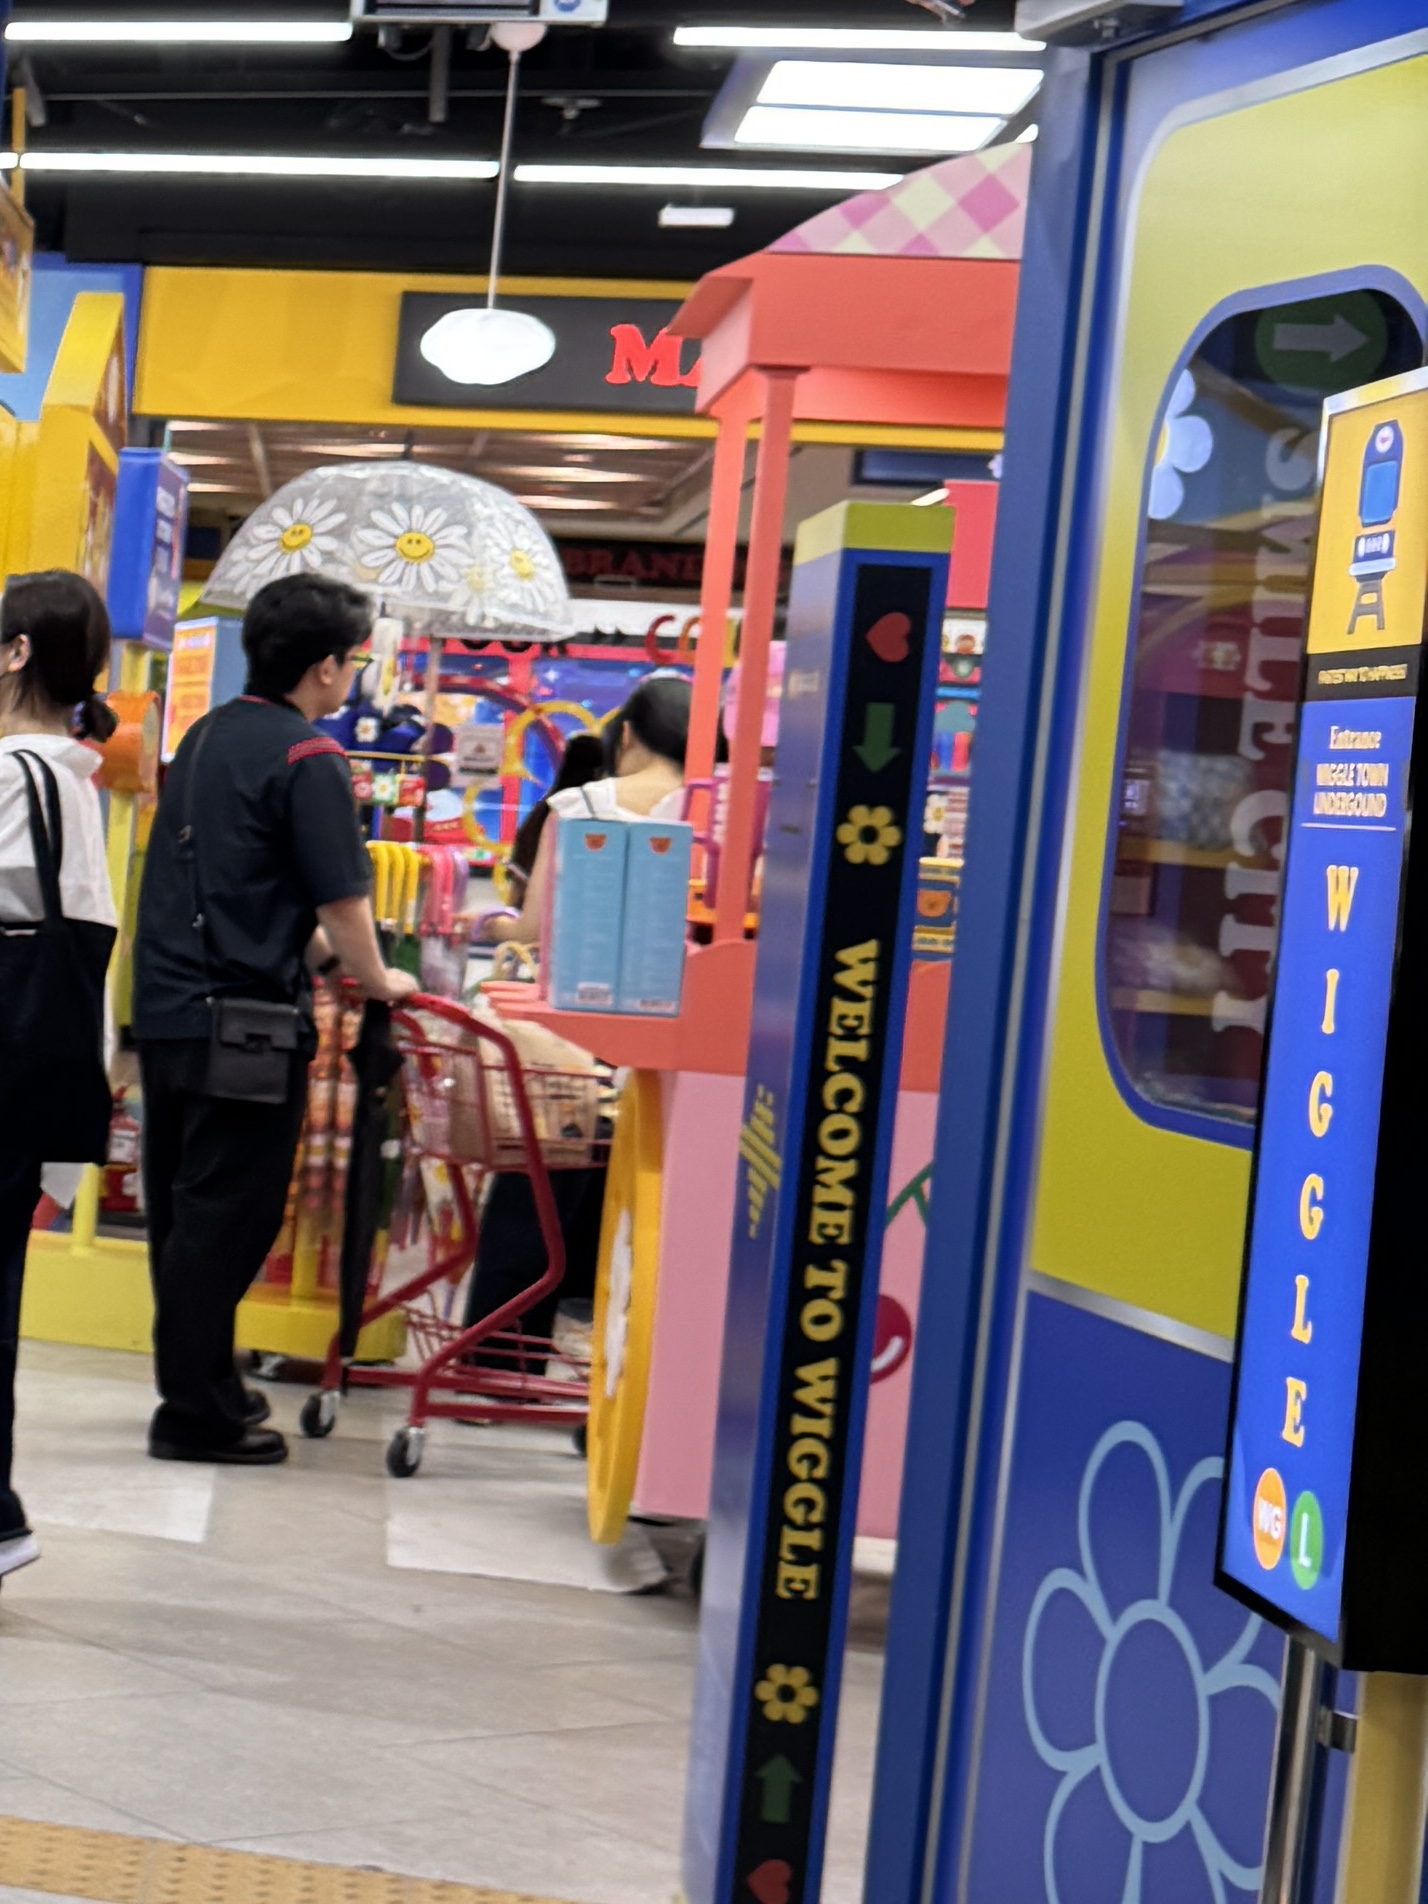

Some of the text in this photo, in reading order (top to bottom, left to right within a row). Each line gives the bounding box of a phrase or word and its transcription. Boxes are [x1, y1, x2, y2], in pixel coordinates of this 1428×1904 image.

[775, 938, 879, 1600] WELCOME TO WIGGLE
[1281, 864, 1359, 1448] WIGGLE
